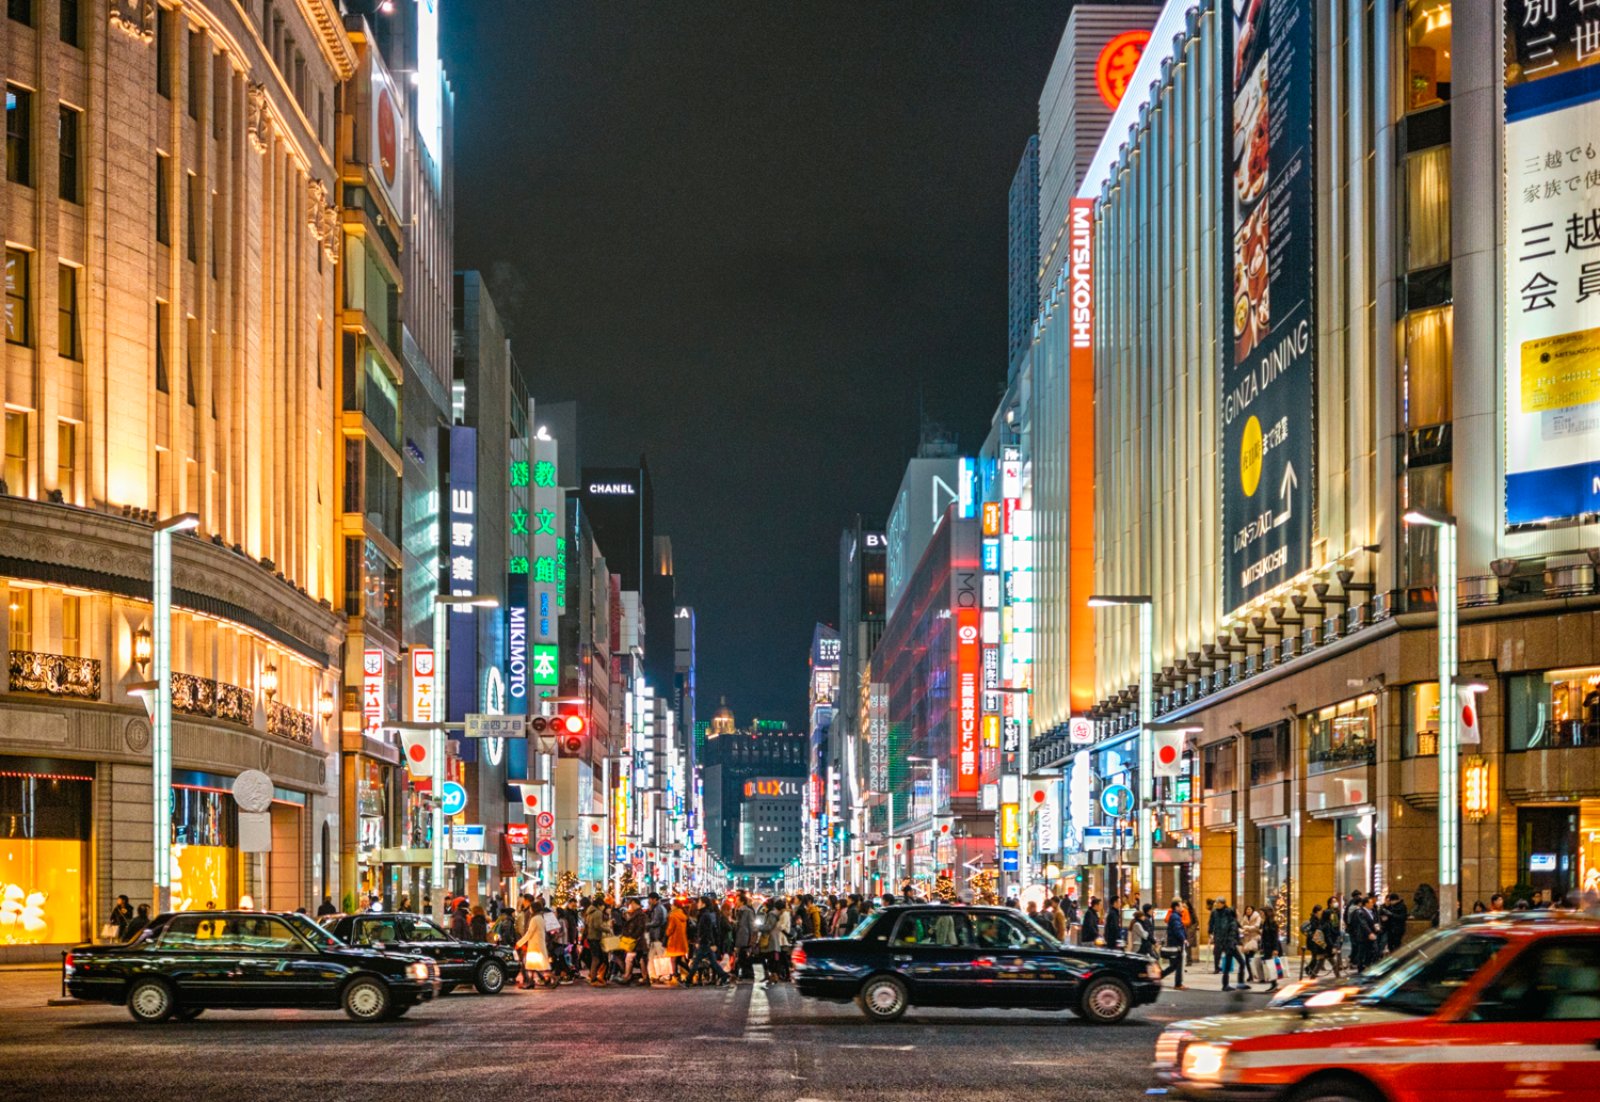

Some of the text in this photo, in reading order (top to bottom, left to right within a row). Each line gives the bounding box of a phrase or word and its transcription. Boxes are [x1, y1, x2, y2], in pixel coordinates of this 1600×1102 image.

[1519, 208, 1600, 262] 三越
[1073, 207, 1090, 348] MITSUKOSHI
[1225, 320, 1308, 425] GINZA DINING
[589, 484, 634, 494] CHANEL
[533, 461, 556, 583] 教文館
[1241, 545, 1288, 588] MITSUKOSHI
[510, 607, 527, 698] MIKIMOTO
[534, 651, 555, 678] 本
[758, 780, 799, 796] LIXIL
